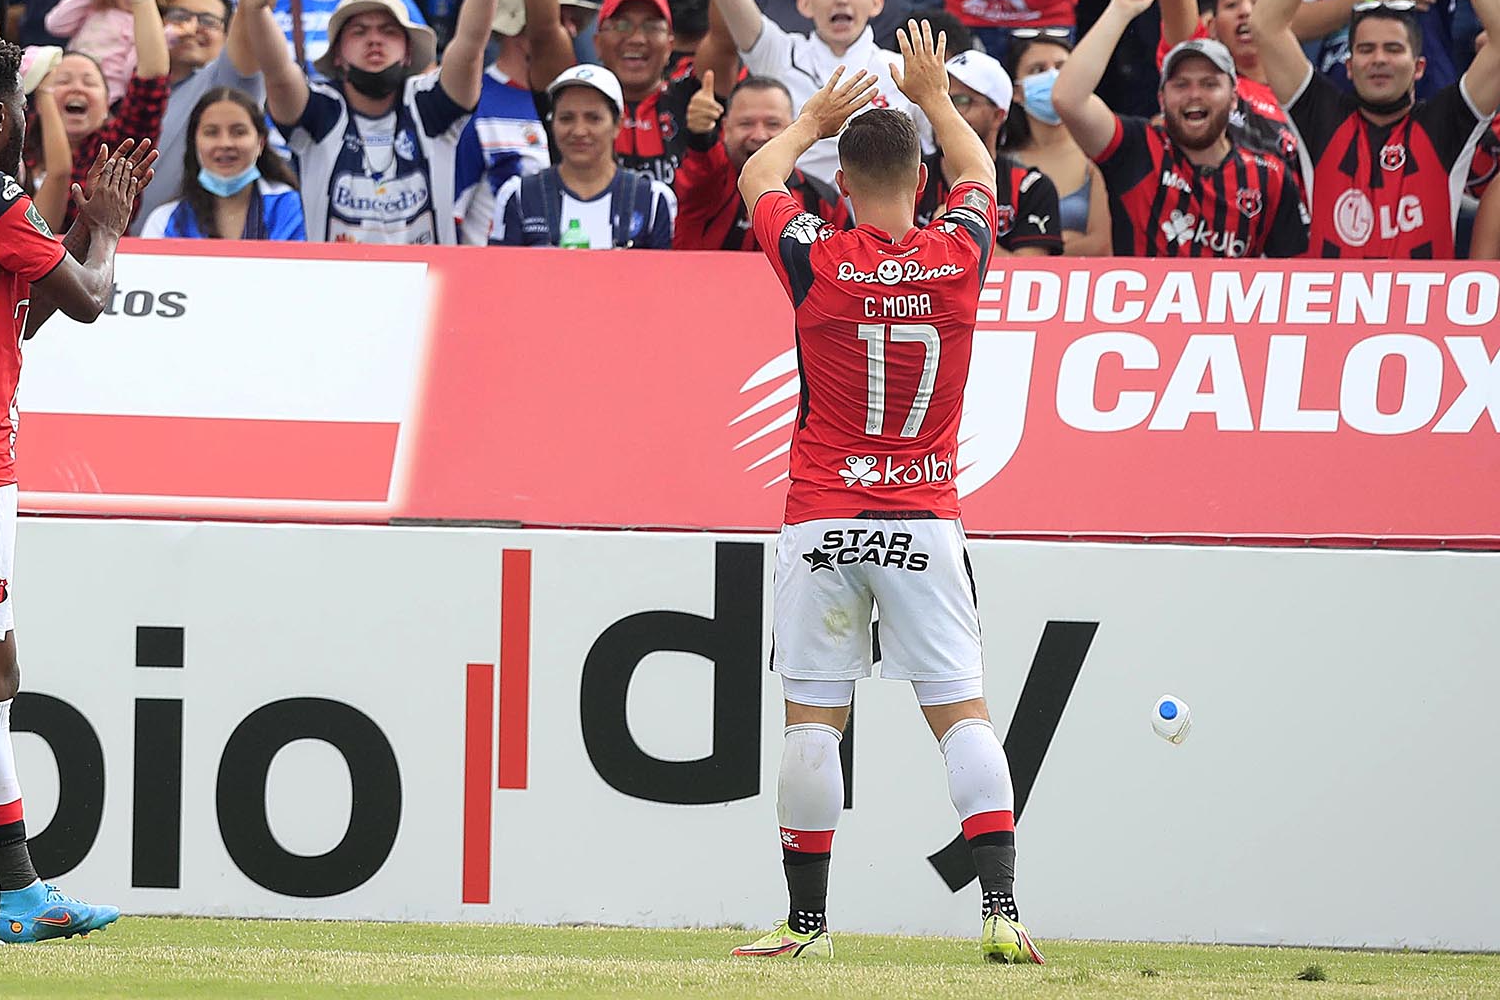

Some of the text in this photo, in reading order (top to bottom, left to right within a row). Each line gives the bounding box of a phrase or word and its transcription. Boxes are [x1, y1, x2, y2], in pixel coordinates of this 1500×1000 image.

[1380, 194, 1423, 240] LG
[837, 260, 965, 285] Dos Pinos
[864, 294, 932, 318] C.MORA
[976, 270, 1500, 326] EDICAMENTO
[857, 323, 941, 438] 17
[1056, 331, 1500, 435] CALOX
[884, 453, 953, 485] kölbi
[822, 529, 913, 552] STAR
[836, 548, 930, 573] CARS
